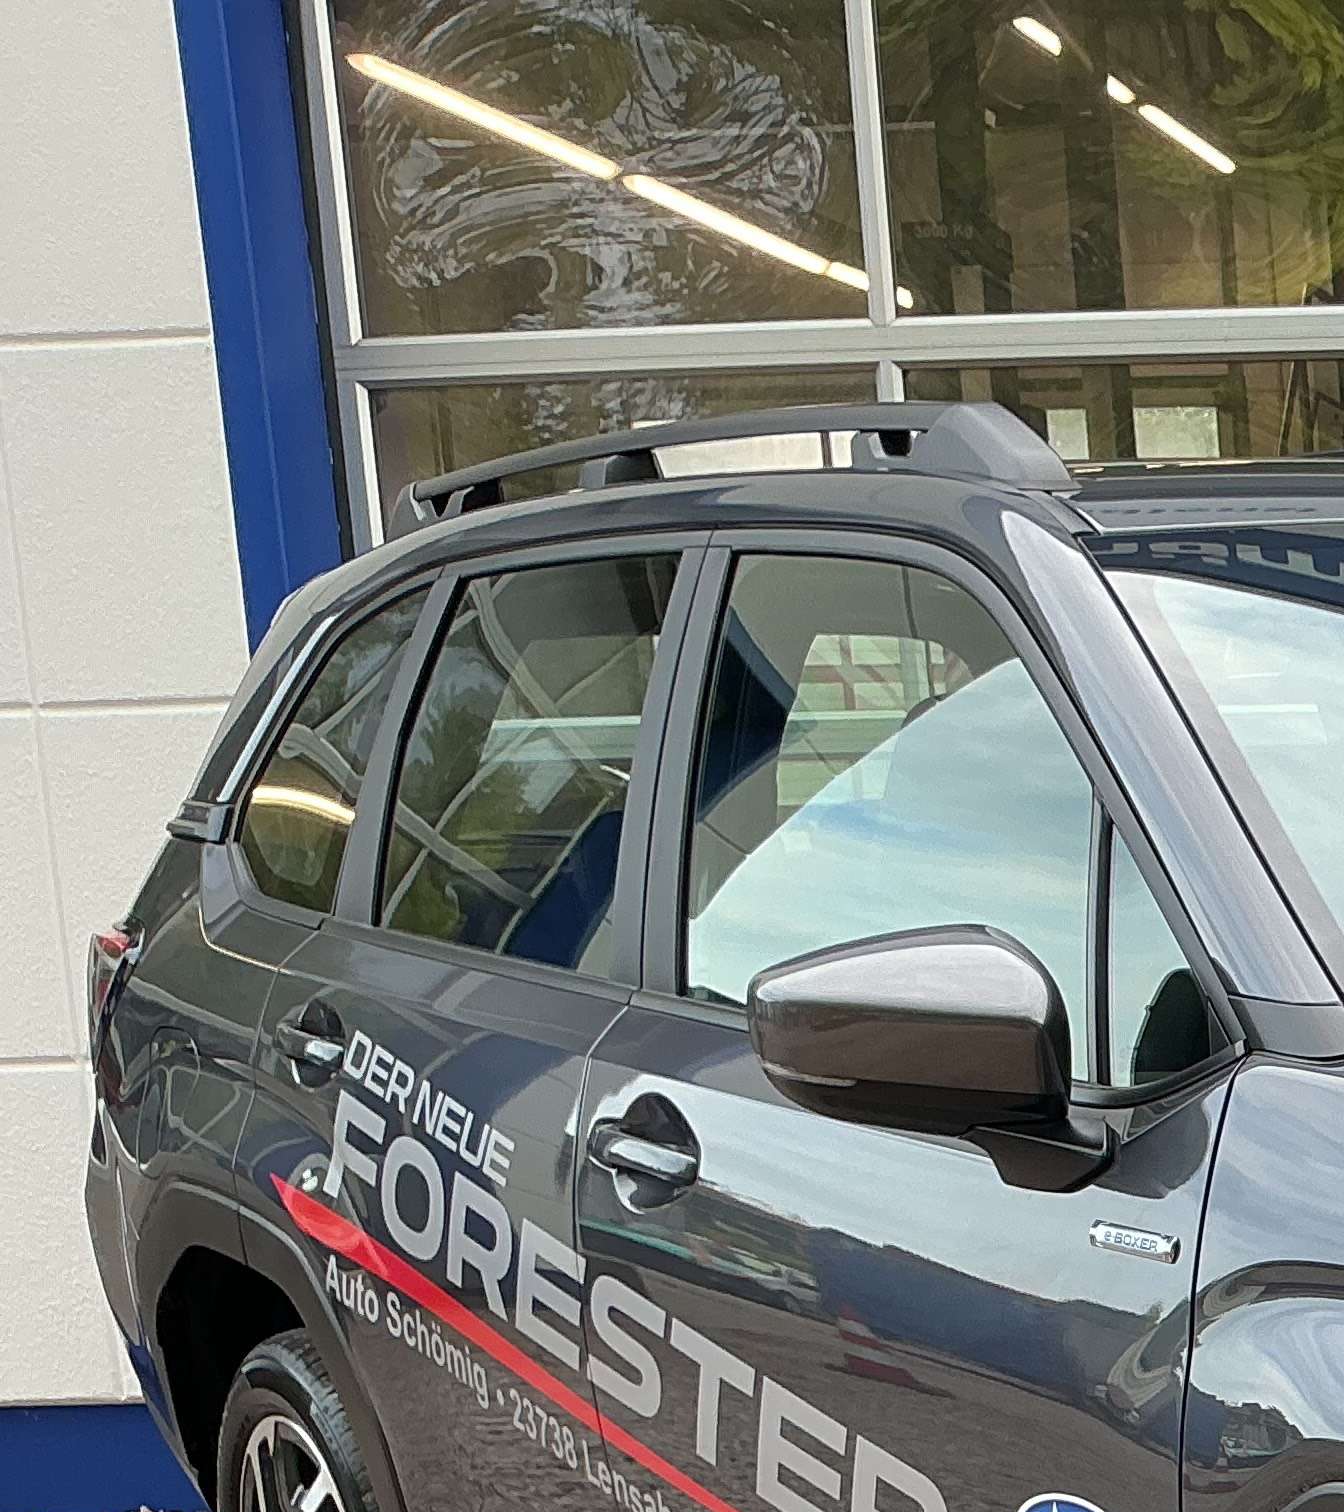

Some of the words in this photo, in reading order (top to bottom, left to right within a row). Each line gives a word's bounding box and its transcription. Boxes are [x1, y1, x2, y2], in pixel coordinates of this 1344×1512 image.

[343, 1028, 417, 1124] DER
[411, 1084, 515, 1187] NEUE
[1103, 1230, 1158, 1252] e-BOXER
[325, 1253, 380, 1324] Auto
[386, 1291, 490, 1411] Schömig
[510, 1387, 578, 1471] 23738
